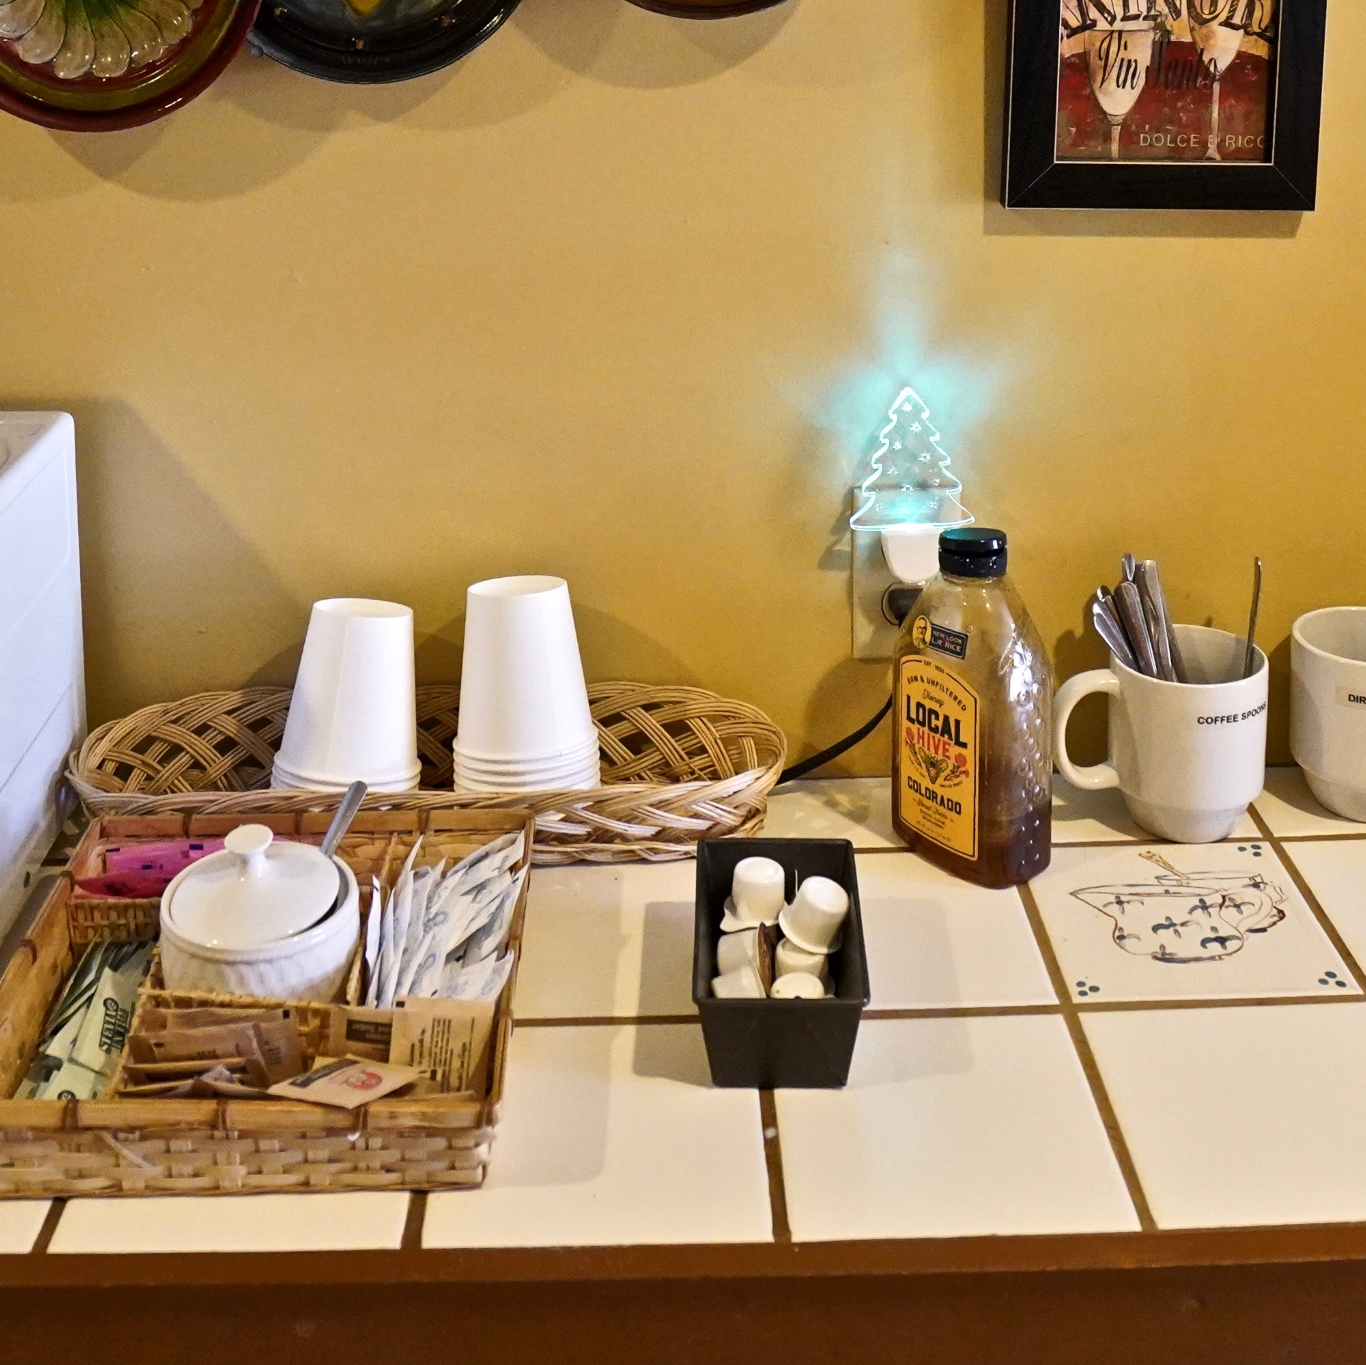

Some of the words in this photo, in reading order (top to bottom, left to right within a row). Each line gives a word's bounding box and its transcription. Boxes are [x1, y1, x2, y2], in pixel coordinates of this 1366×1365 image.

[1098, 30, 1141, 90] Vin
[1139, 133, 1201, 147] DOLCE
[945, 642, 962, 653] RICE
[946, 635, 963, 644] LOOK
[907, 675, 919, 684] RAW
[926, 677, 967, 711] UNFILTERED
[906, 694, 968, 749] LOCAL
[1197, 713, 1239, 725] COFFEE
[1241, 700, 1268, 721] SPOONS
[916, 727, 951, 760] HIVE
[907, 776, 962, 815] COLORADO
